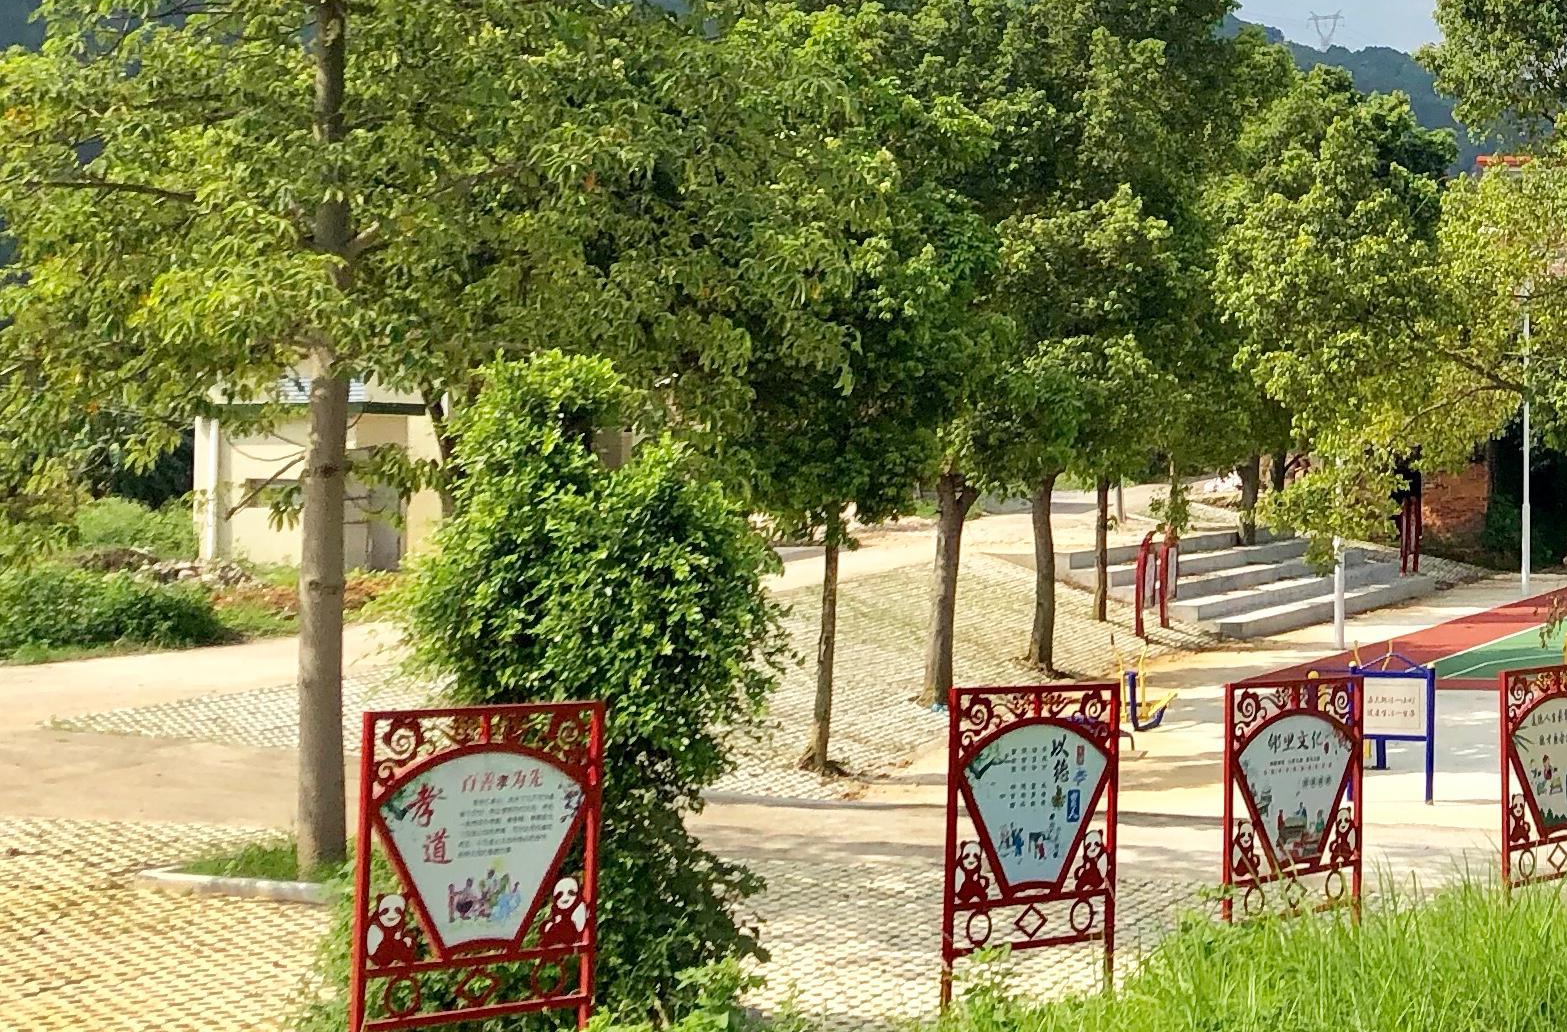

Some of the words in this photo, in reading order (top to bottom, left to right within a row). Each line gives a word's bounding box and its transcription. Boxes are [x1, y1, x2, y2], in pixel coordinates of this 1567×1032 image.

[460, 768, 544, 793] 百善孝为先
[406, 782, 453, 865] 孝道
